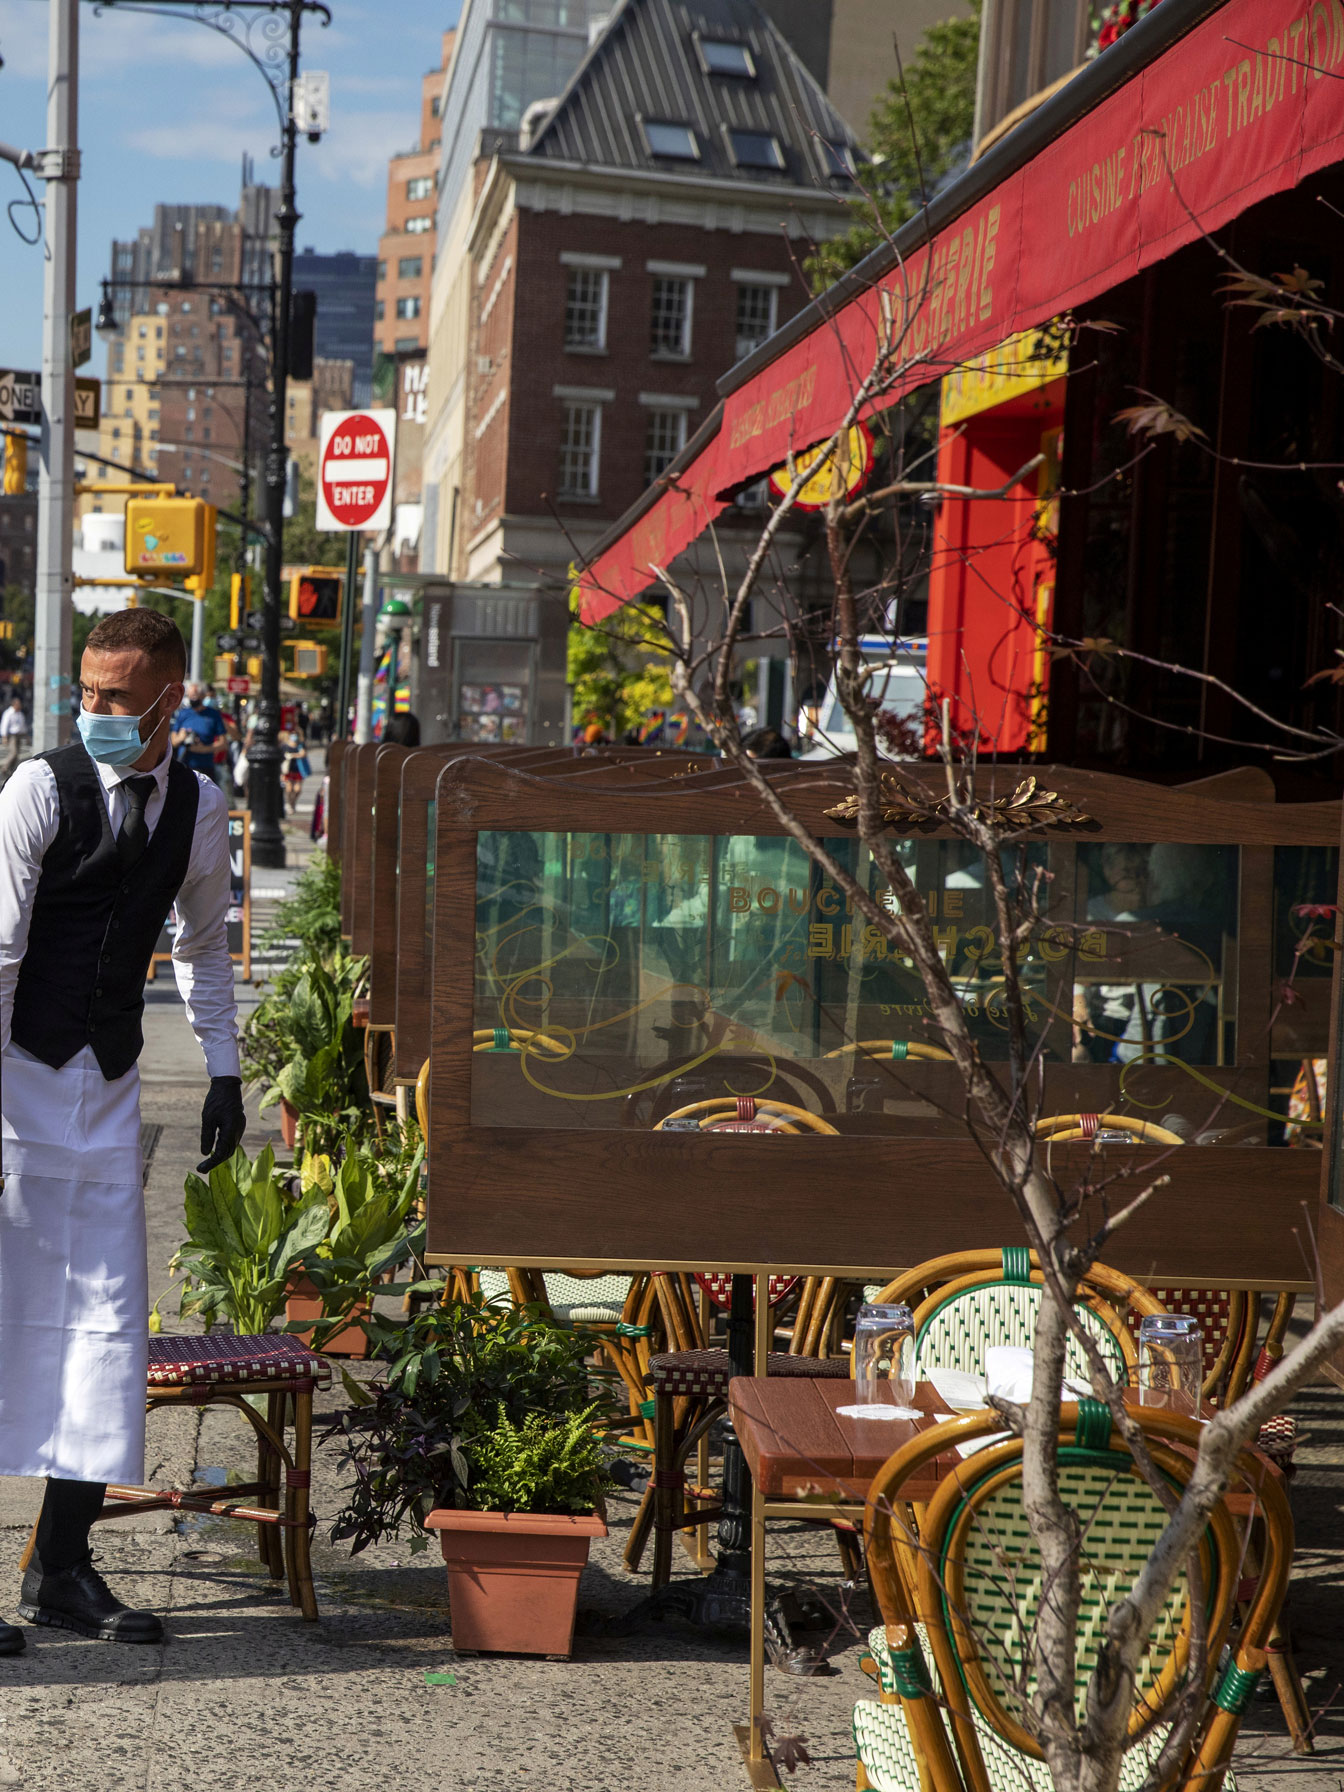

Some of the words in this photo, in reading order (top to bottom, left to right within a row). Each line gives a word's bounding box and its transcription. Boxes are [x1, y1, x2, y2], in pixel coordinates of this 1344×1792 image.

[1068, 147, 1125, 238] CUISINE
[333, 436, 352, 456] DO
[355, 433, 381, 455] NOT
[333, 485, 375, 507] ENTER
[728, 886, 964, 918] BOUCEIE
